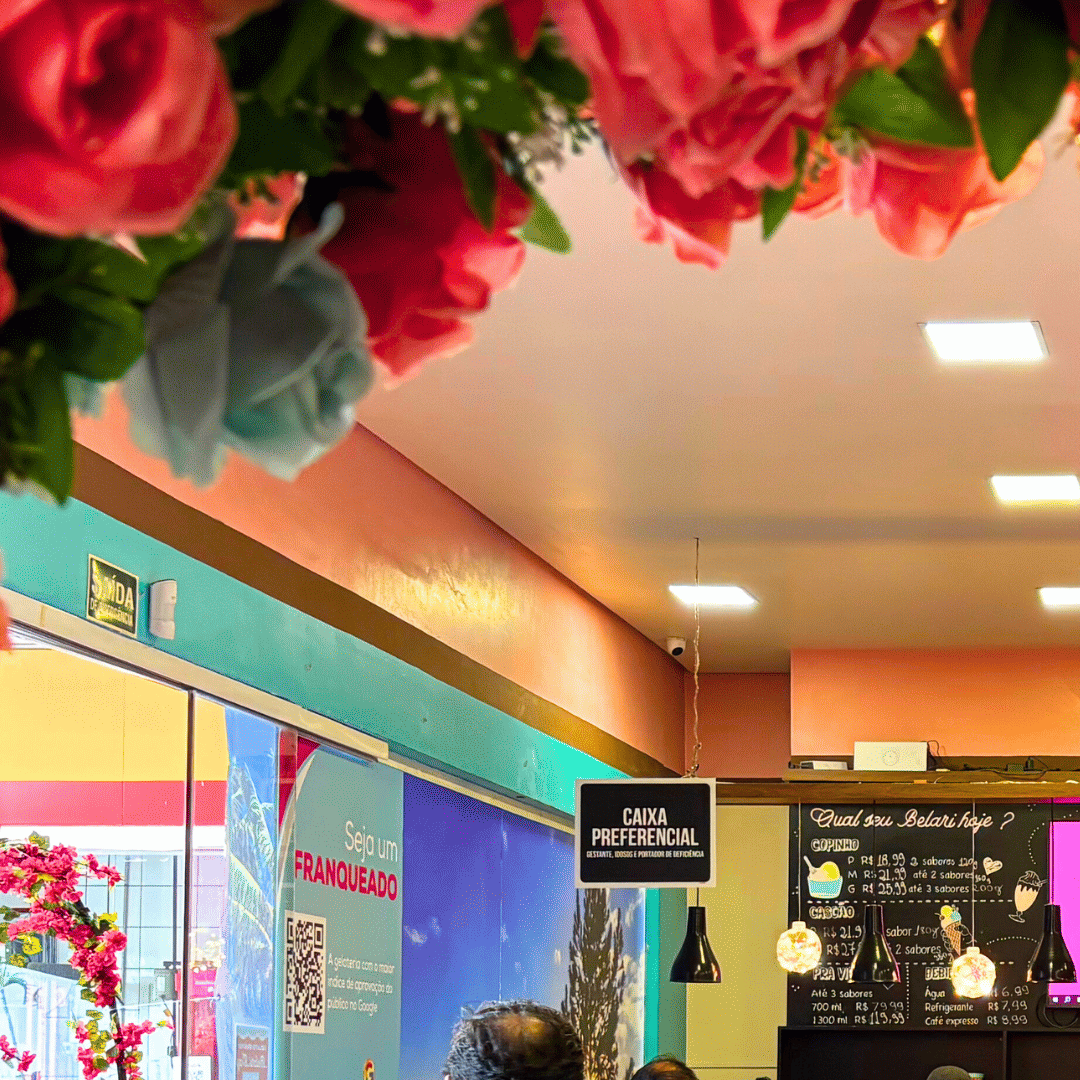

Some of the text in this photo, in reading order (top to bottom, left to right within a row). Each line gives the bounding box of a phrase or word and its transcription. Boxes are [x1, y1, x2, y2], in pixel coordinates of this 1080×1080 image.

[622, 807, 668, 826] CAIXA
[810, 807, 863, 828] Qual
[863, 813, 893, 828] seu
[897, 808, 957, 828] Belari
[957, 811, 993, 834] hoje
[344, 820, 398, 863] Seja um
[591, 827, 699, 847] PREFERENCIAL
[810, 838, 860, 853] COPINHO
[847, 856, 855, 865] P
[922, 855, 956, 866] sabores
[295, 849, 398, 901] FRANQUEADO
[847, 870, 858, 879] M
[912, 869, 928, 879] até
[930, 870, 937, 880] 2
[939, 870, 974, 880] sabores
[847, 884, 856, 894] G
[908, 883, 923, 894] até
[926, 884, 932, 893] 3
[934, 883, 970, 894] sabores
[809, 901, 856, 920] CASCÃO
[886, 926, 912, 937] sabor
[826, 942, 839, 957] R$
[895, 944, 902, 955] 2
[905, 944, 942, 955] sabores
[813, 966, 836, 981] PRA
[811, 988, 873, 998] Até 3 sabores
[924, 985, 946, 1001] Água
[811, 1002, 829, 1012] 700
[855, 1001, 869, 1012] R$
[924, 1002, 974, 1014] Refrigerante
[987, 1001, 999, 1012] R$
[813, 1015, 836, 1025] 1300
[837, 1015, 848, 1025] ml
[854, 1015, 867, 1025] R$
[924, 1016, 943, 1026] Café
[945, 1018, 979, 1027] expresso
[986, 1015, 998, 1025] R$
